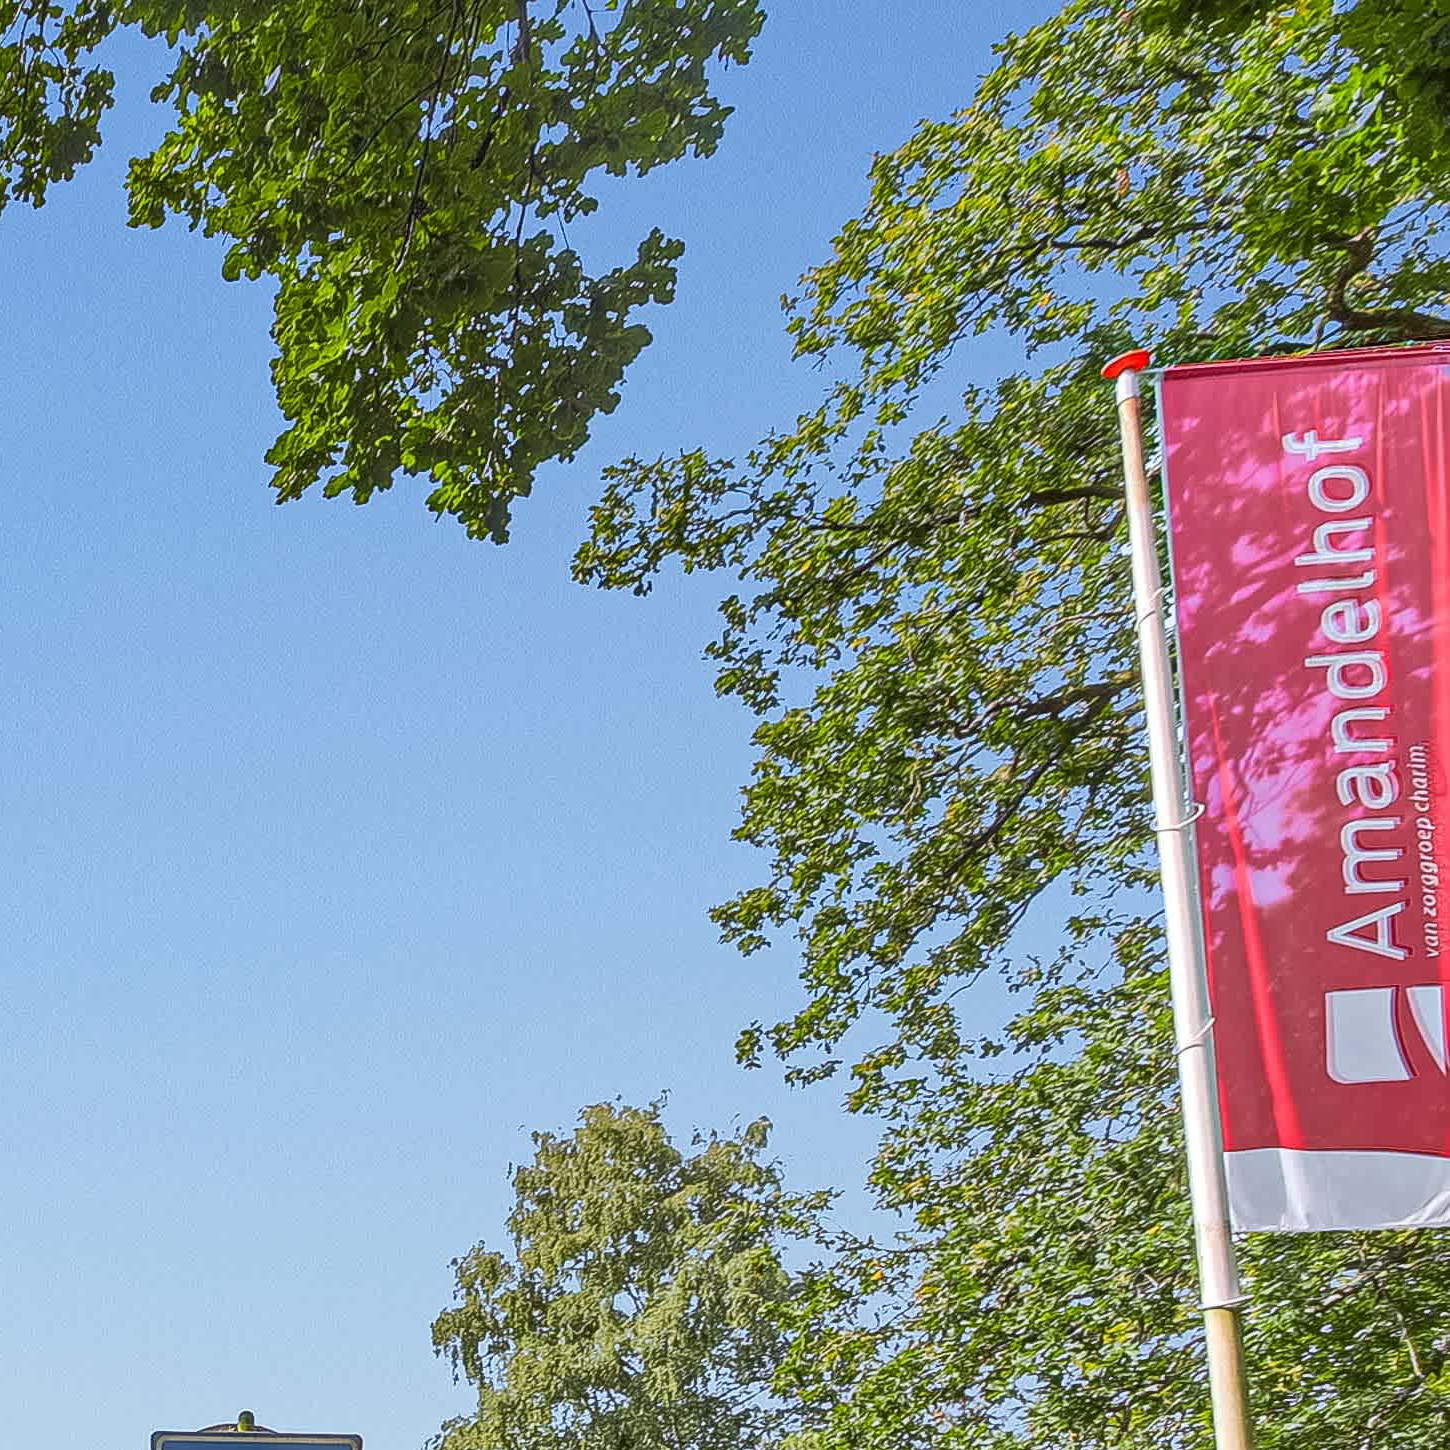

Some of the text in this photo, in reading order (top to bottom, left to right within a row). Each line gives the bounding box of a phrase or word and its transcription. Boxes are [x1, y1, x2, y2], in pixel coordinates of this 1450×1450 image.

[1282, 429, 1405, 960] Amandelhof
[1406, 744, 1439, 958] van zorggroep charim
